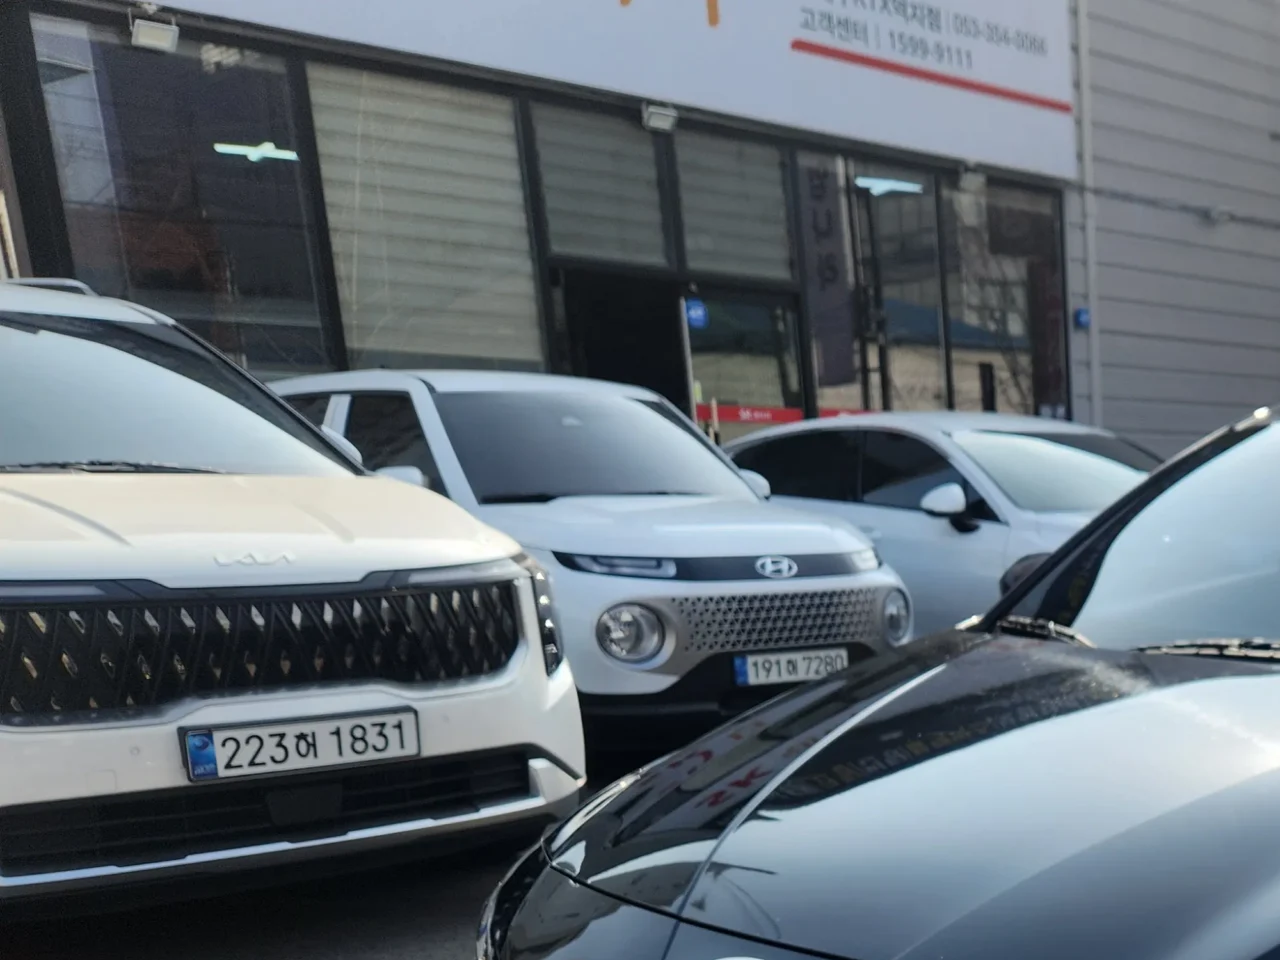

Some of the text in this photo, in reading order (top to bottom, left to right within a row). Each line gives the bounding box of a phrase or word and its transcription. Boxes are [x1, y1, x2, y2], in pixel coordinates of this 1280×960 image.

[800, 8, 973, 69] 고객센터 1599-9111
[802, 654, 845, 677] 7280
[220, 719, 405, 770] 223허 1831
